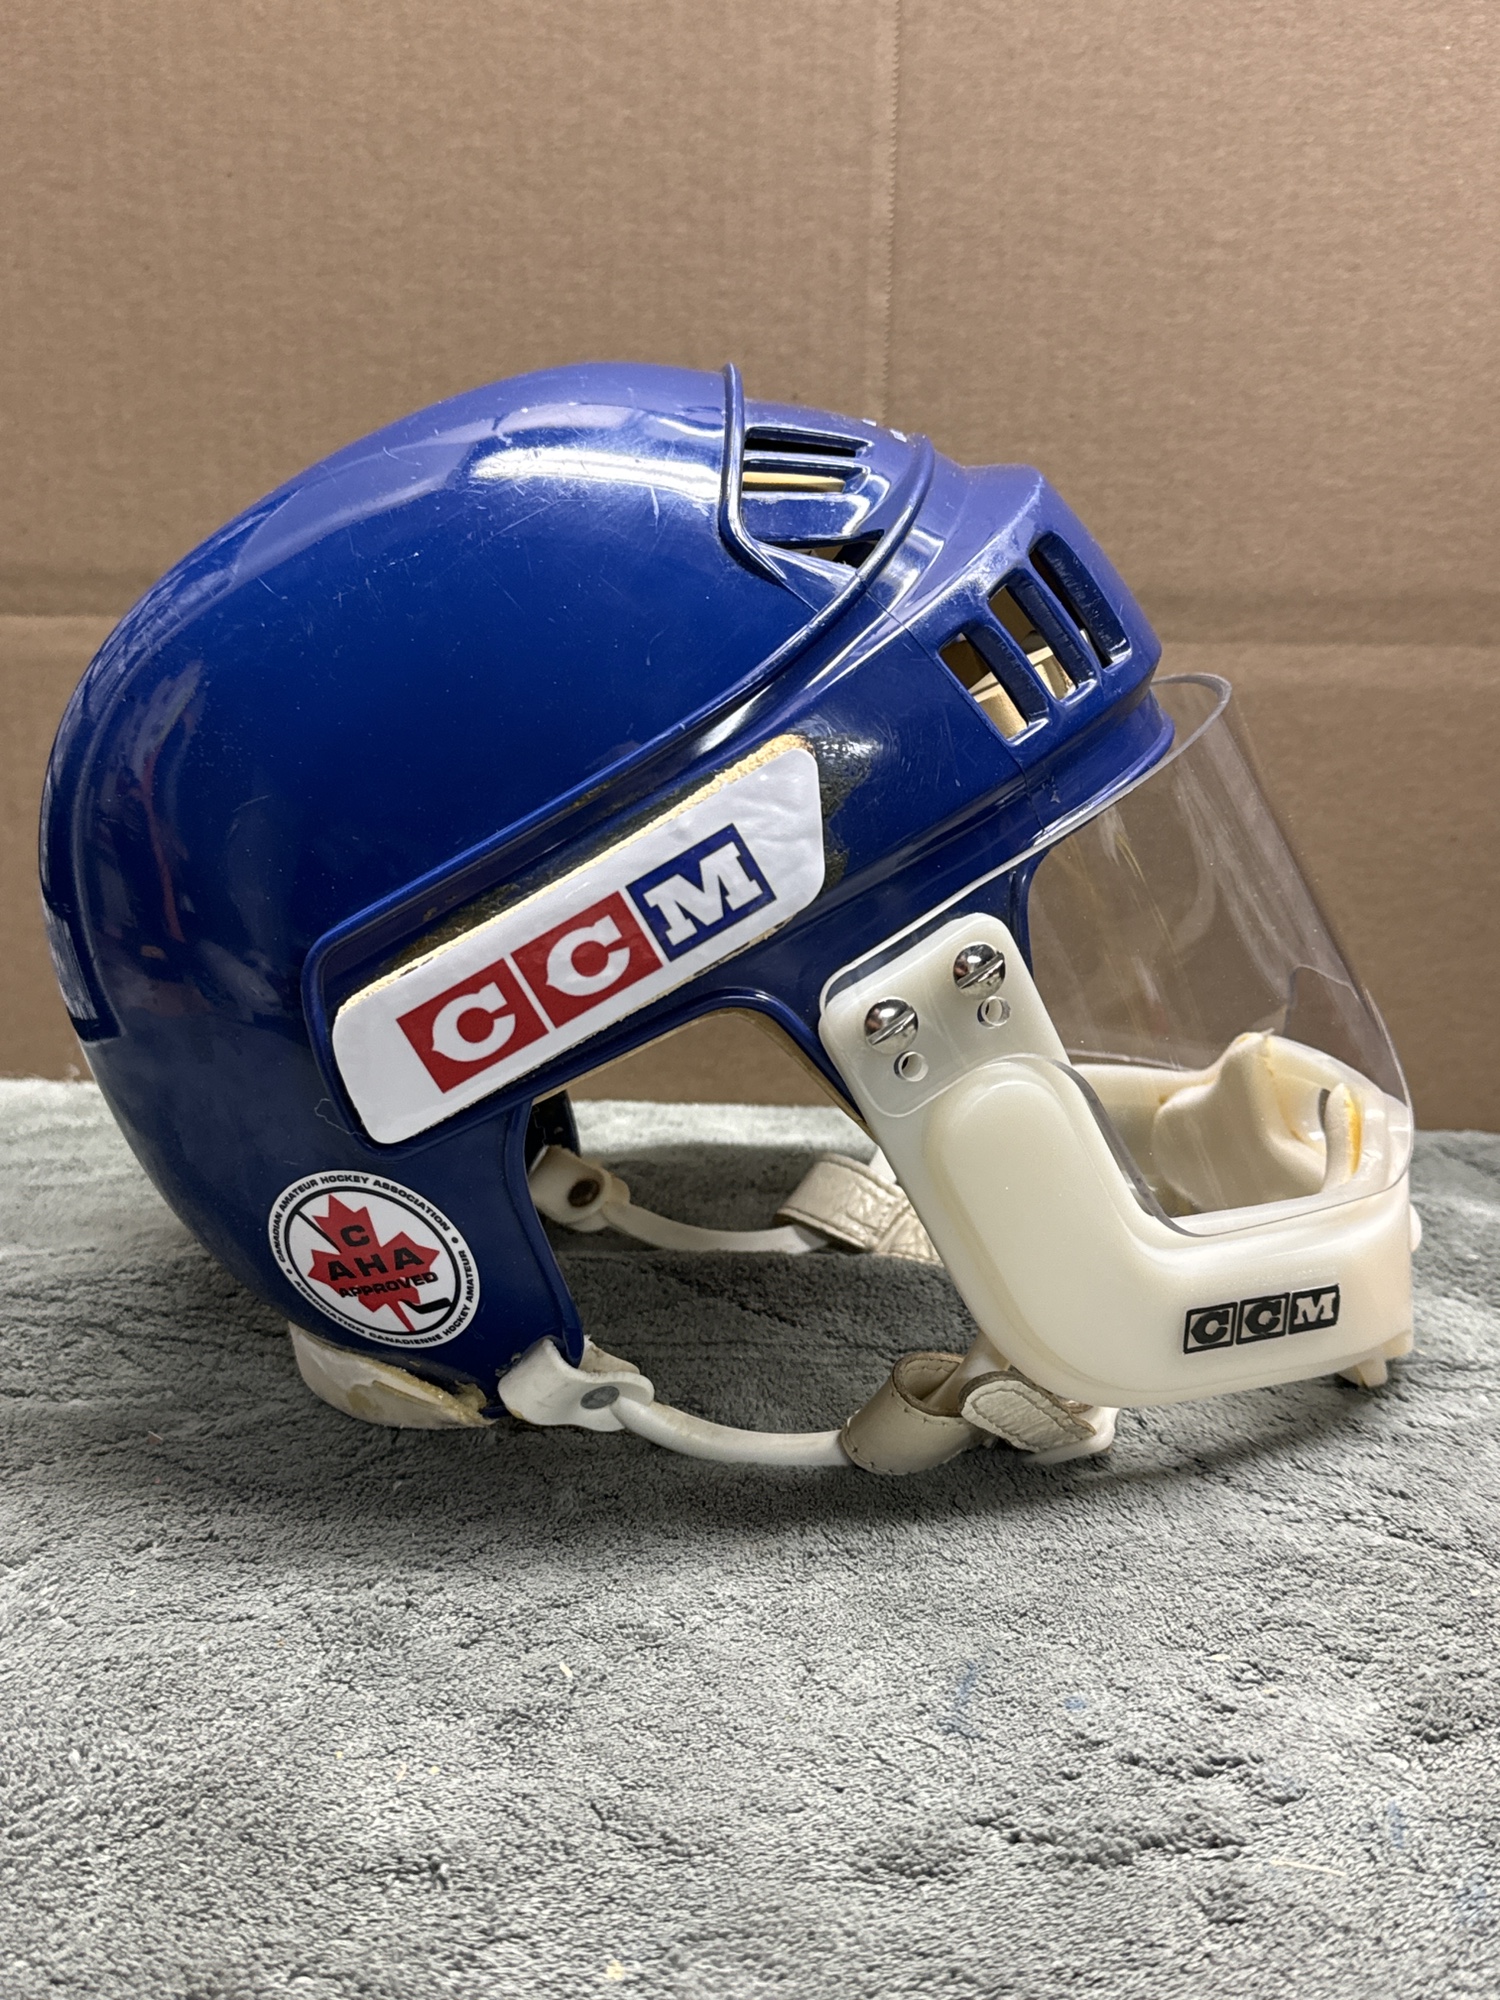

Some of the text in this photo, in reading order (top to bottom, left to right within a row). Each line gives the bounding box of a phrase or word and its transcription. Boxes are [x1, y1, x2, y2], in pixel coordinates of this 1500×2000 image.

[431, 841, 763, 1063] CCM
[270, 1174, 451, 1263] CANADIAN AMATEUR HOCKEY ASSOCIATION
[340, 1224, 370, 1247] C
[327, 1246, 425, 1281] AHA
[338, 1271, 439, 1299] APPROVED
[293, 1249, 475, 1346] ASSOCIATION CANADIENNE HOCKEY AMATEUR
[1190, 1291, 1337, 1345] CCM
